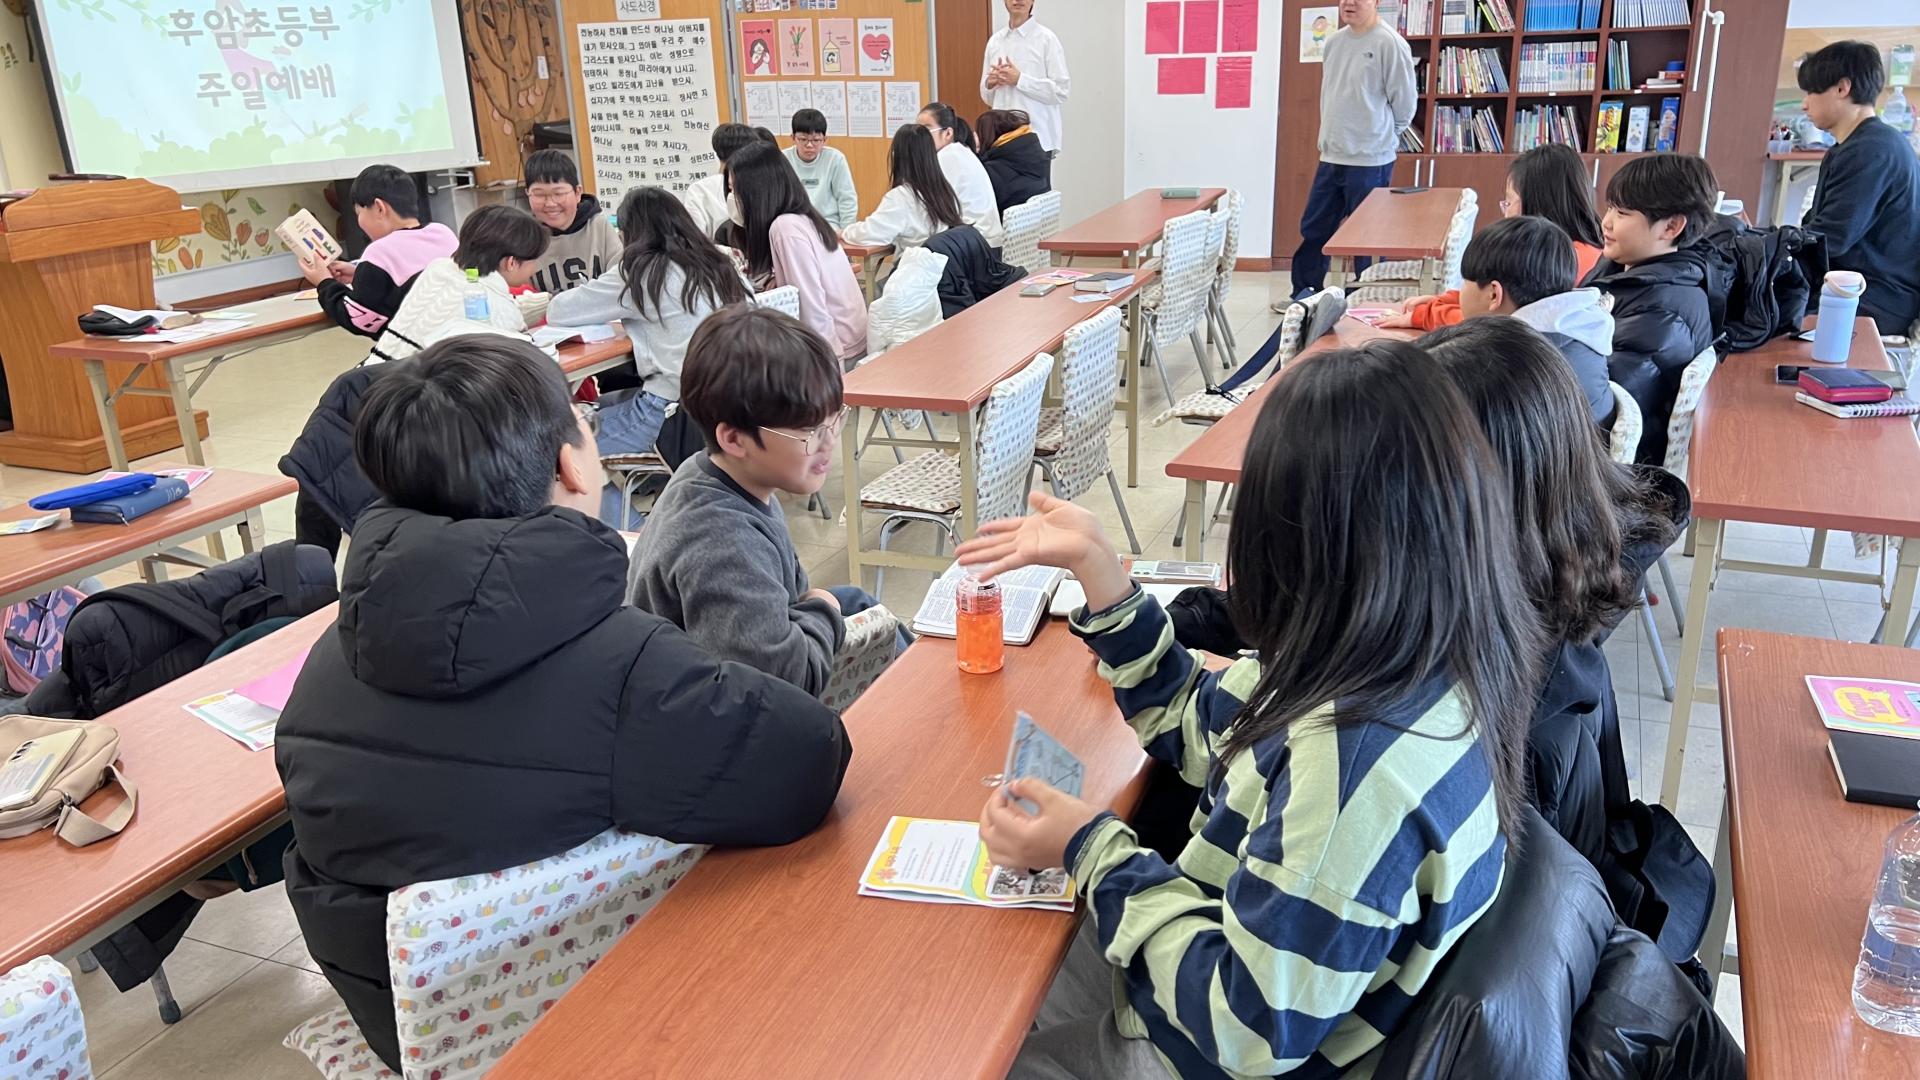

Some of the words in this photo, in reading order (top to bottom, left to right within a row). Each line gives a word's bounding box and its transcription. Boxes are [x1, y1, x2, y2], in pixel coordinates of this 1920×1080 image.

[620, 0, 656, 12] 사도신경
[168, 6, 340, 49] 후암초등부
[654, 24, 674, 34] 하나님
[679, 23, 705, 33] 아버지를
[661, 36, 674, 45] 우리
[678, 36, 684, 44] 주
[650, 51, 662, 60] 이는
[196, 63, 336, 110] 주일예배
[594, 136, 612, 147] 하나님
